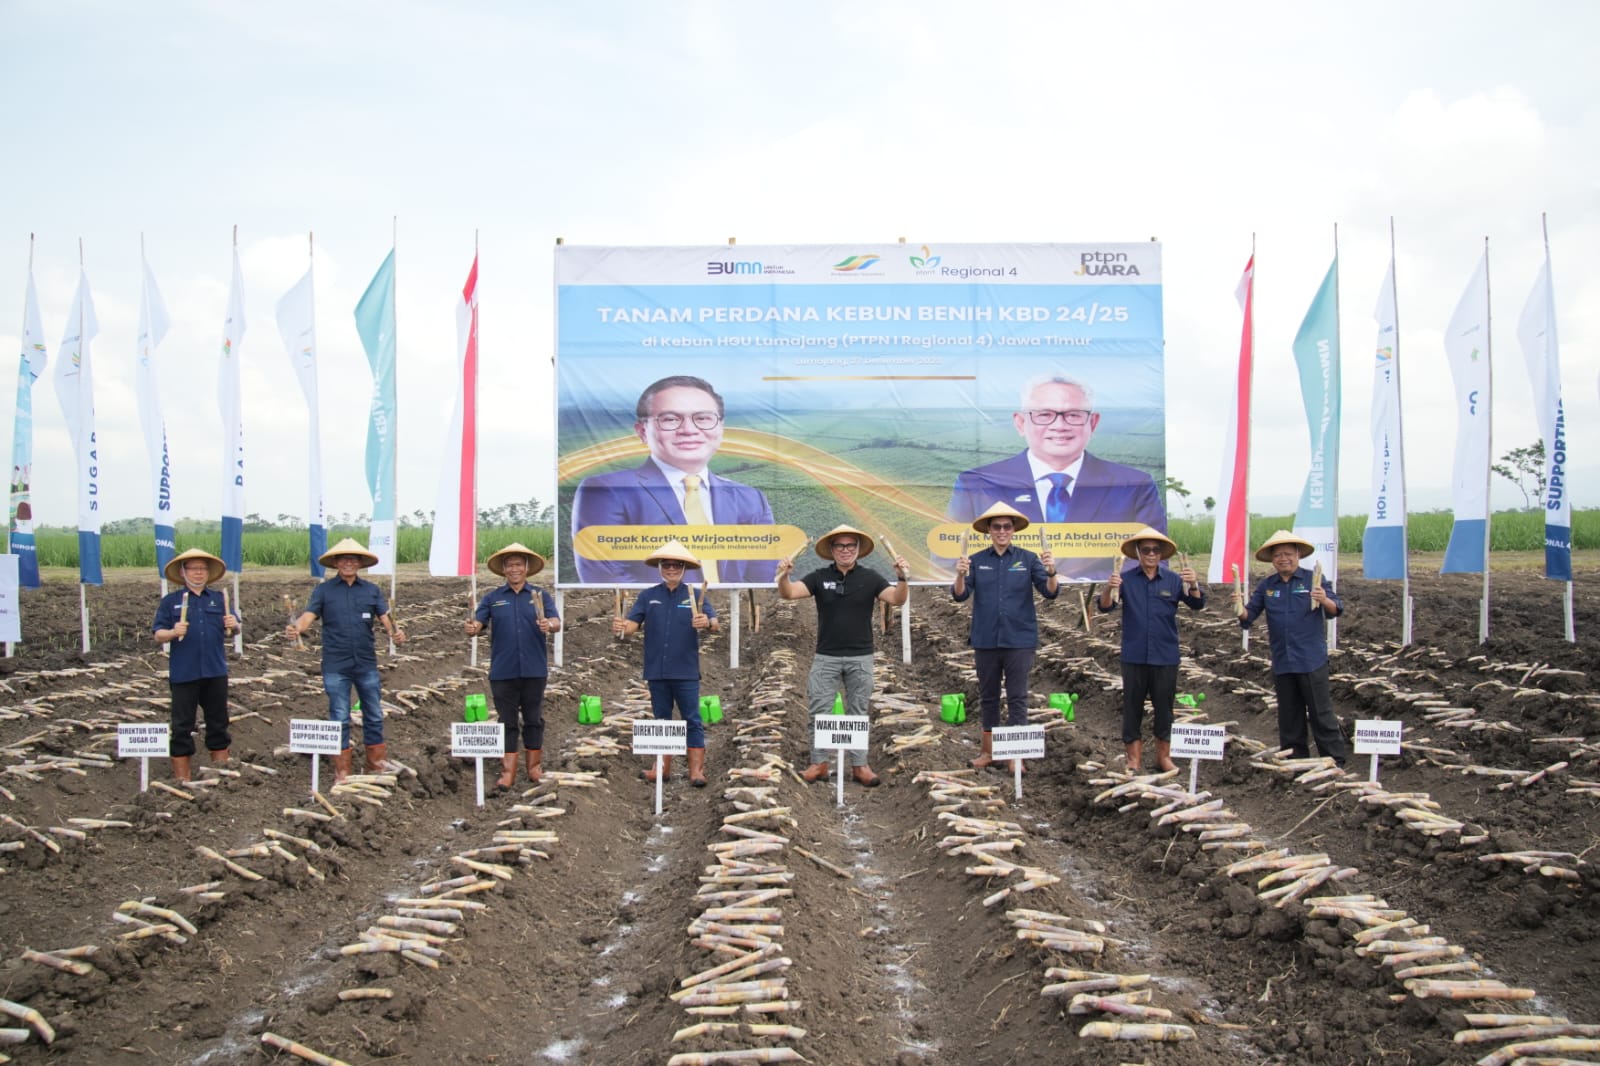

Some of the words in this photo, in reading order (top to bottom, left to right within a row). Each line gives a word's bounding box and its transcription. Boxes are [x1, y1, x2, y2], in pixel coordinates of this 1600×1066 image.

[1080, 250, 1128, 264] ptpn
[941, 266, 1004, 279] Regional
[1008, 267, 1018, 276] 4
[1073, 264, 1140, 276] JUARA
[596, 308, 692, 322] TANAM
[698, 306, 820, 322] PERDANA
[827, 306, 912, 321] KEBUN
[918, 306, 992, 321] BENIH
[998, 306, 1050, 321] KBD
[1056, 302, 1128, 325] 24/25
[642, 336, 656, 346] di
[661, 336, 712, 346] Kebun
[718, 336, 752, 346] HGU
[756, 336, 838, 348] Lumajang
[842, 333, 890, 348] (PTPN
[902, 335, 972, 348] Regional
[976, 333, 992, 349] 4)
[998, 336, 1040, 346] Jawa
[1045, 336, 1092, 346] Timur
[597, 534, 638, 545] Bapak
[692, 534, 781, 544] Wirjoatmodjo
[939, 534, 980, 543] Bapk
[1064, 532, 1102, 540] Abdul
[456, 725, 476, 734] DIREKTUR
[634, 725, 663, 736] DIREKTUR
[665, 726, 686, 736] UTAMA
[816, 720, 838, 730] WAKIL
[840, 720, 868, 731] MENTERI
[1007, 732, 1028, 741] DIREKTUR
[1172, 728, 1201, 736] DIREKTUR
[463, 736, 497, 746] PENGEMBANGAN
[832, 734, 851, 744] BUMN
